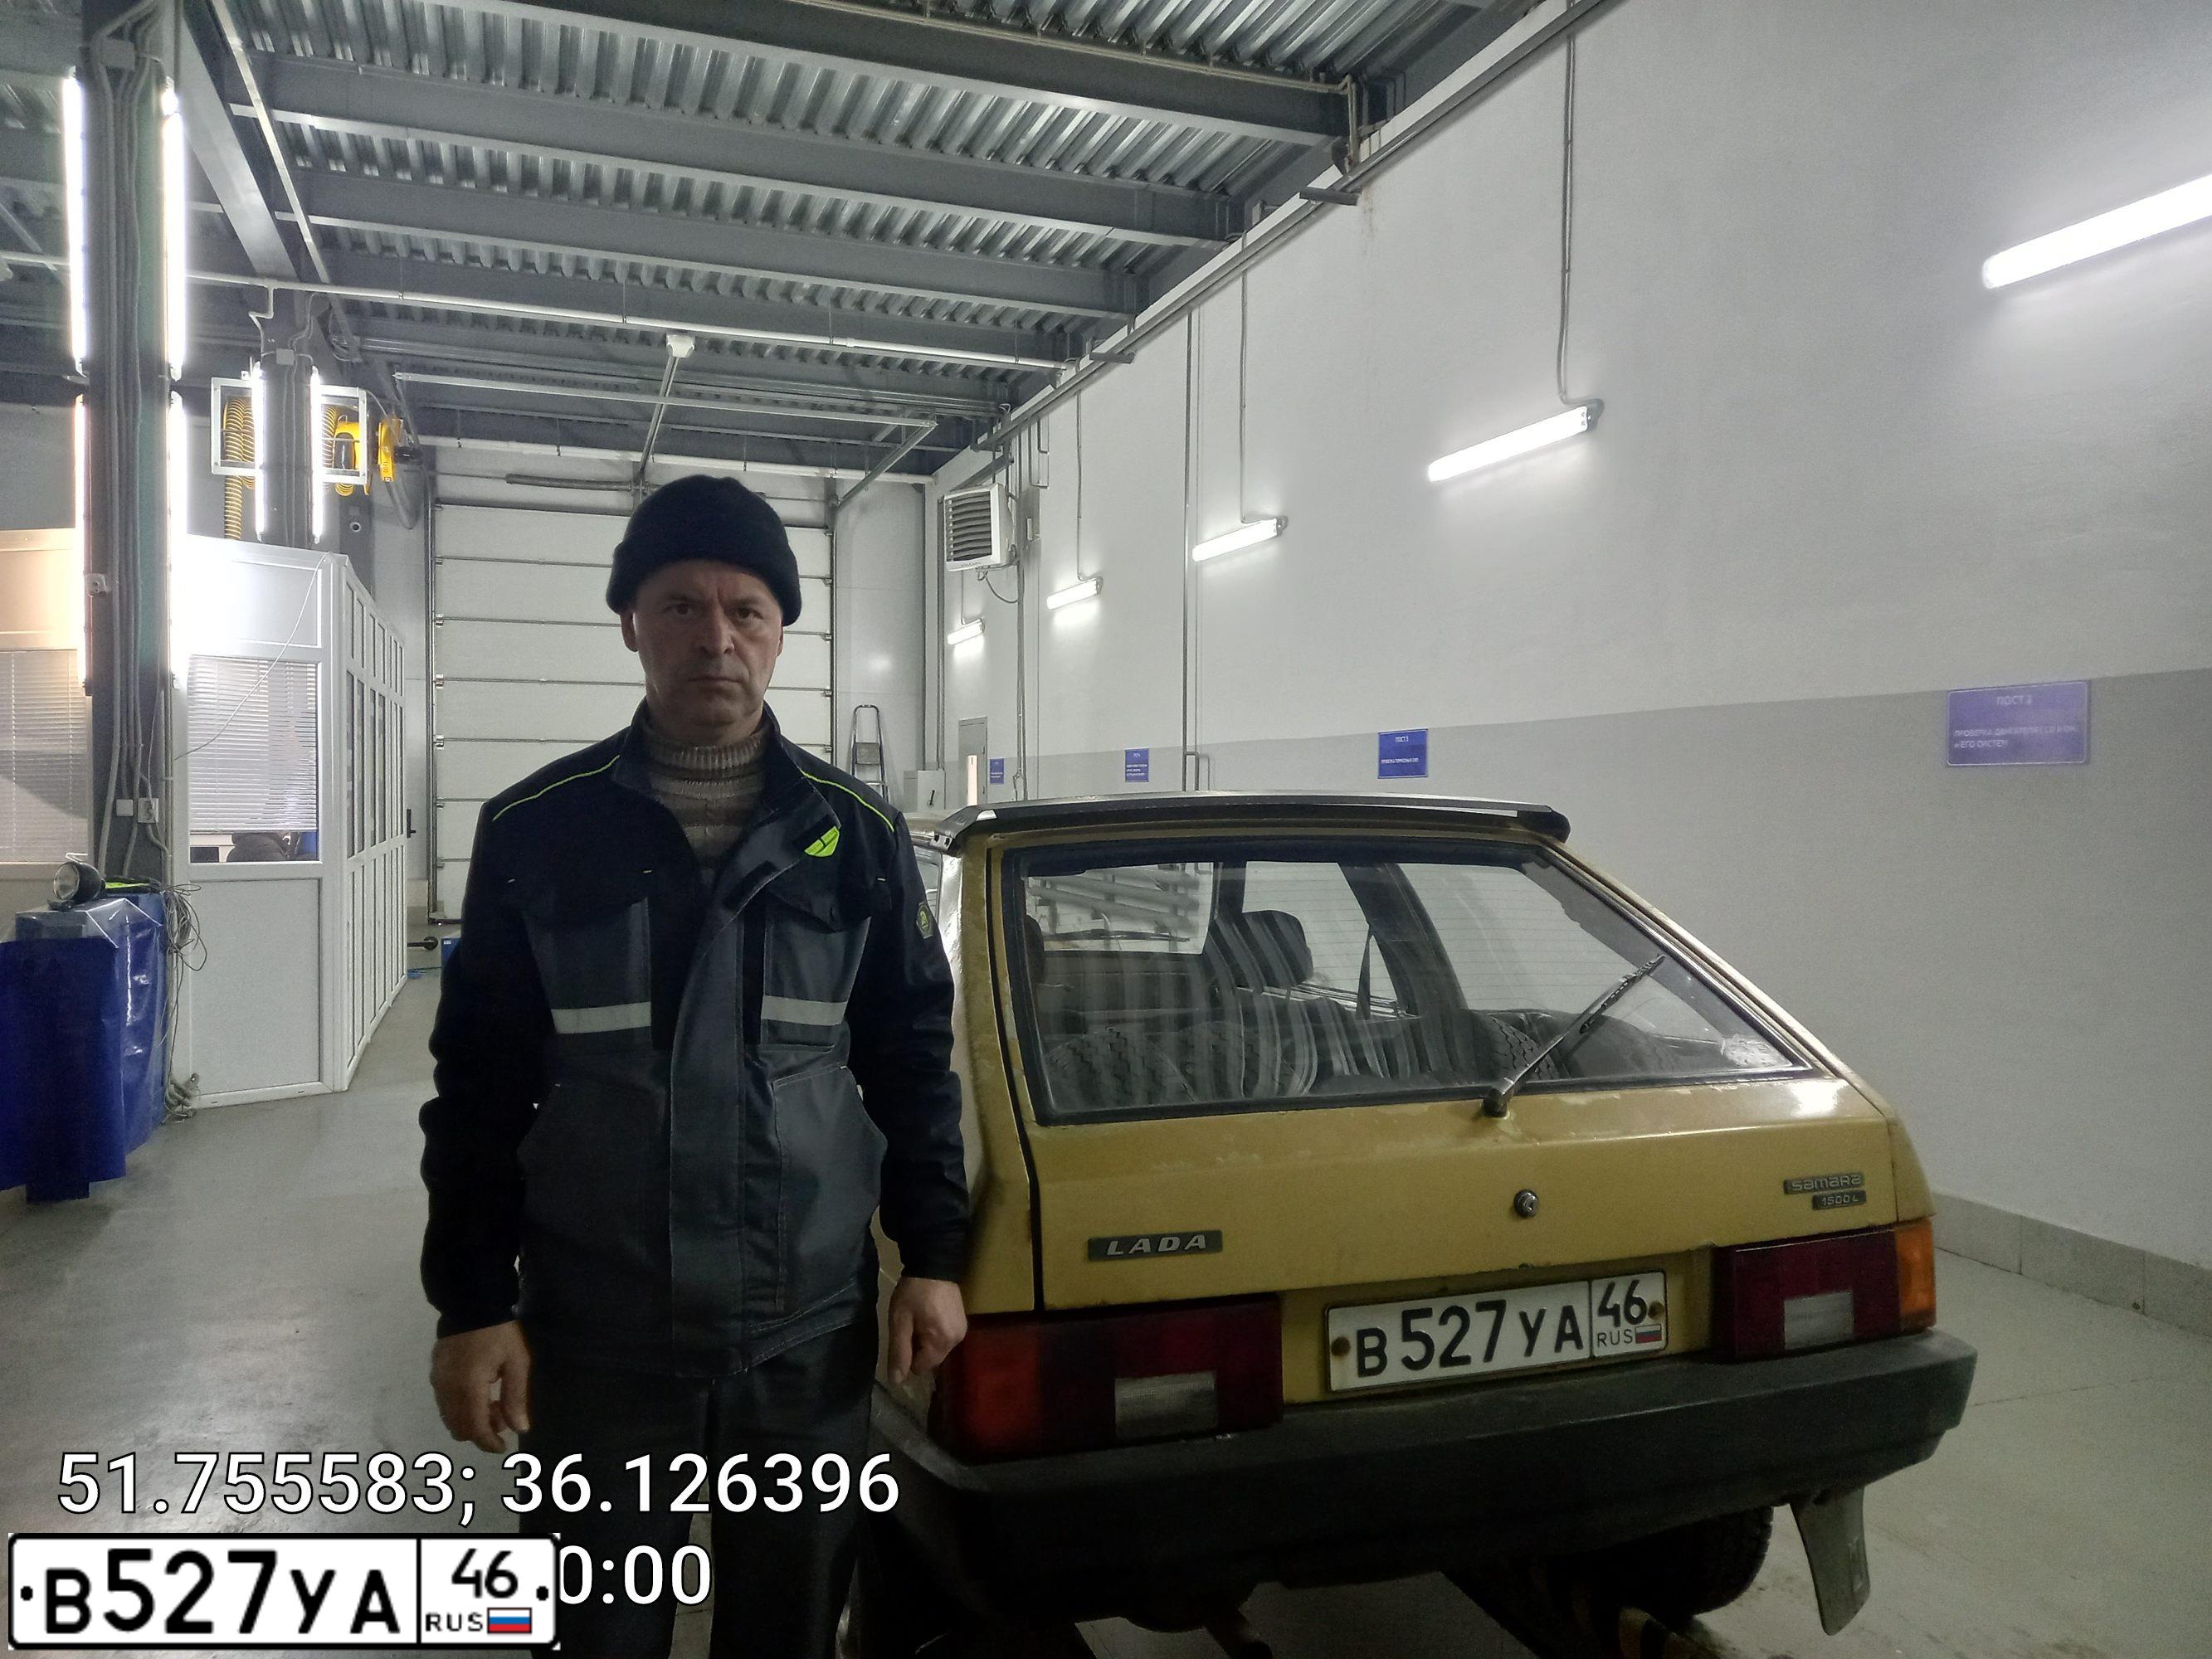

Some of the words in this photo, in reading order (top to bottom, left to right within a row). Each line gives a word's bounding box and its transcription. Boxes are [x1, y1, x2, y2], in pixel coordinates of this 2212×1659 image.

[1996, 695, 2024, 706] ПОСТ
[1821, 1194, 1850, 1205] 1500
[1106, 1234, 1206, 1256] LADA
[1597, 1280, 1648, 1327] 46
[1596, 1329, 1634, 1348] RUS
